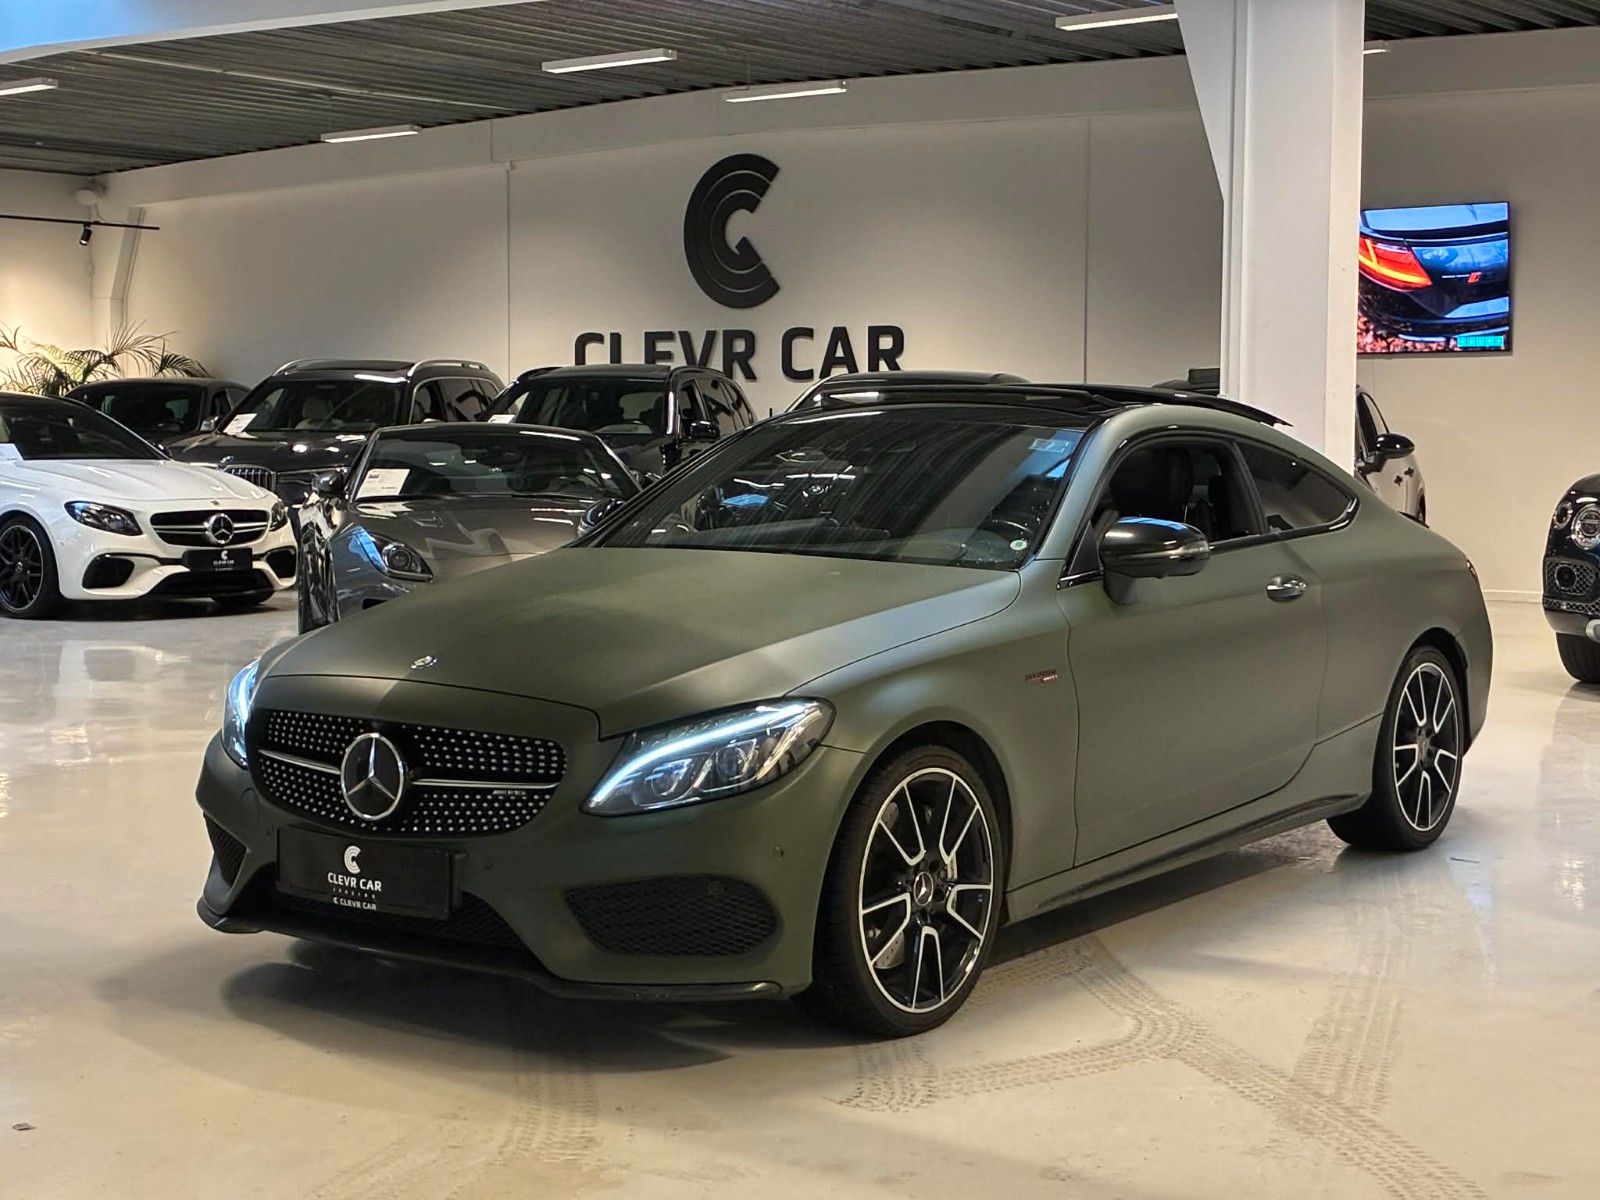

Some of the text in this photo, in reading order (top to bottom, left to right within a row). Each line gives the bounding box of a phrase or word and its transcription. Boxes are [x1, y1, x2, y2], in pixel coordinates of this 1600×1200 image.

[781, 325, 905, 380] CAR
[328, 872, 382, 892] CLEVR CAR
[340, 898, 361, 909] CLEVR
[362, 902, 377, 911] CAR
